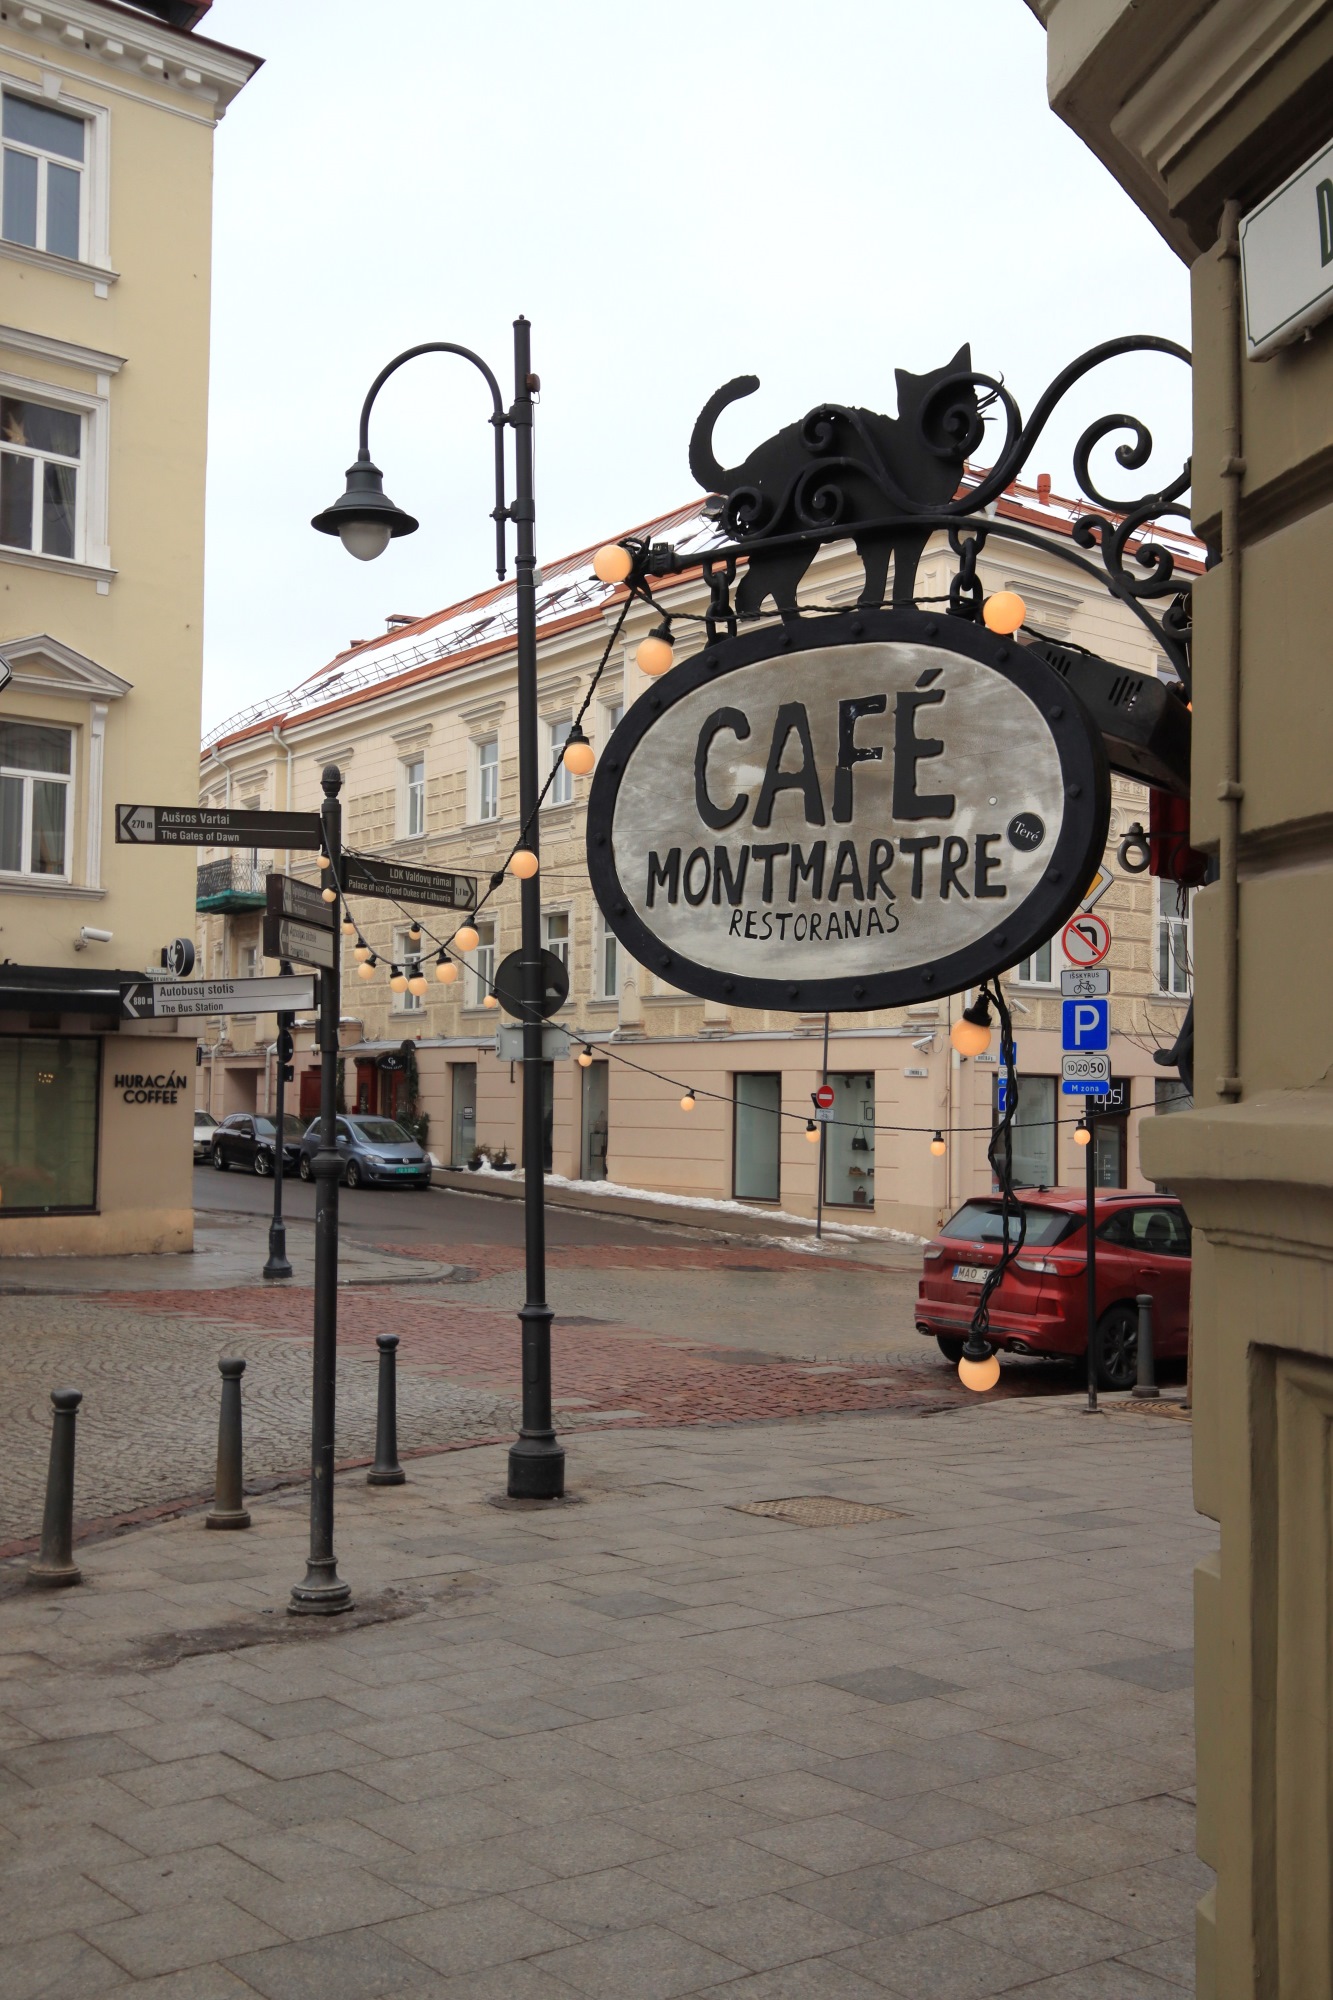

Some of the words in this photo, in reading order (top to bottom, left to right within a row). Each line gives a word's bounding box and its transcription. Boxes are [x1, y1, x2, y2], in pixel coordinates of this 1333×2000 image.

[694, 668, 956, 831] CAFÉ
[131, 819, 145, 829] 270
[146, 821, 153, 829] m
[161, 811, 197, 824] Aušros
[200, 812, 230, 825] Vartai
[161, 830, 177, 840] The
[179, 831, 204, 841] Gates
[206, 831, 214, 842] of
[216, 832, 240, 842] Dawn
[1015, 821, 1041, 842] Teré
[389, 868, 404, 880] LDK
[405, 870, 432, 886] Valdovų
[432, 875, 452, 887] rūmai
[645, 832, 1007, 908] MONTMARTRE
[348, 879, 368, 891] Palace
[368, 882, 375, 891] of
[385, 885, 402, 896] Grand
[402, 887, 420, 898] Dukes
[420, 890, 426, 899] of
[426, 891, 451, 903] Lithuania
[729, 902, 900, 942] RESTORANAS
[159, 986, 205, 998] Autobusų
[207, 984, 235, 994] stotis
[133, 996, 146, 1005] 880
[161, 1004, 176, 1013] The
[178, 1003, 193, 1013] Bus
[195, 1002, 224, 1012] Station
[1074, 1005, 1099, 1045] P
[1068, 1064, 1075, 1072] 10
[1077, 1063, 1088, 1072] 20
[1090, 1062, 1104, 1073] 50
[114, 1069, 187, 1089] HURACÁN
[1071, 1084, 1078, 1092] M
[123, 1089, 178, 1104] COFFEE
